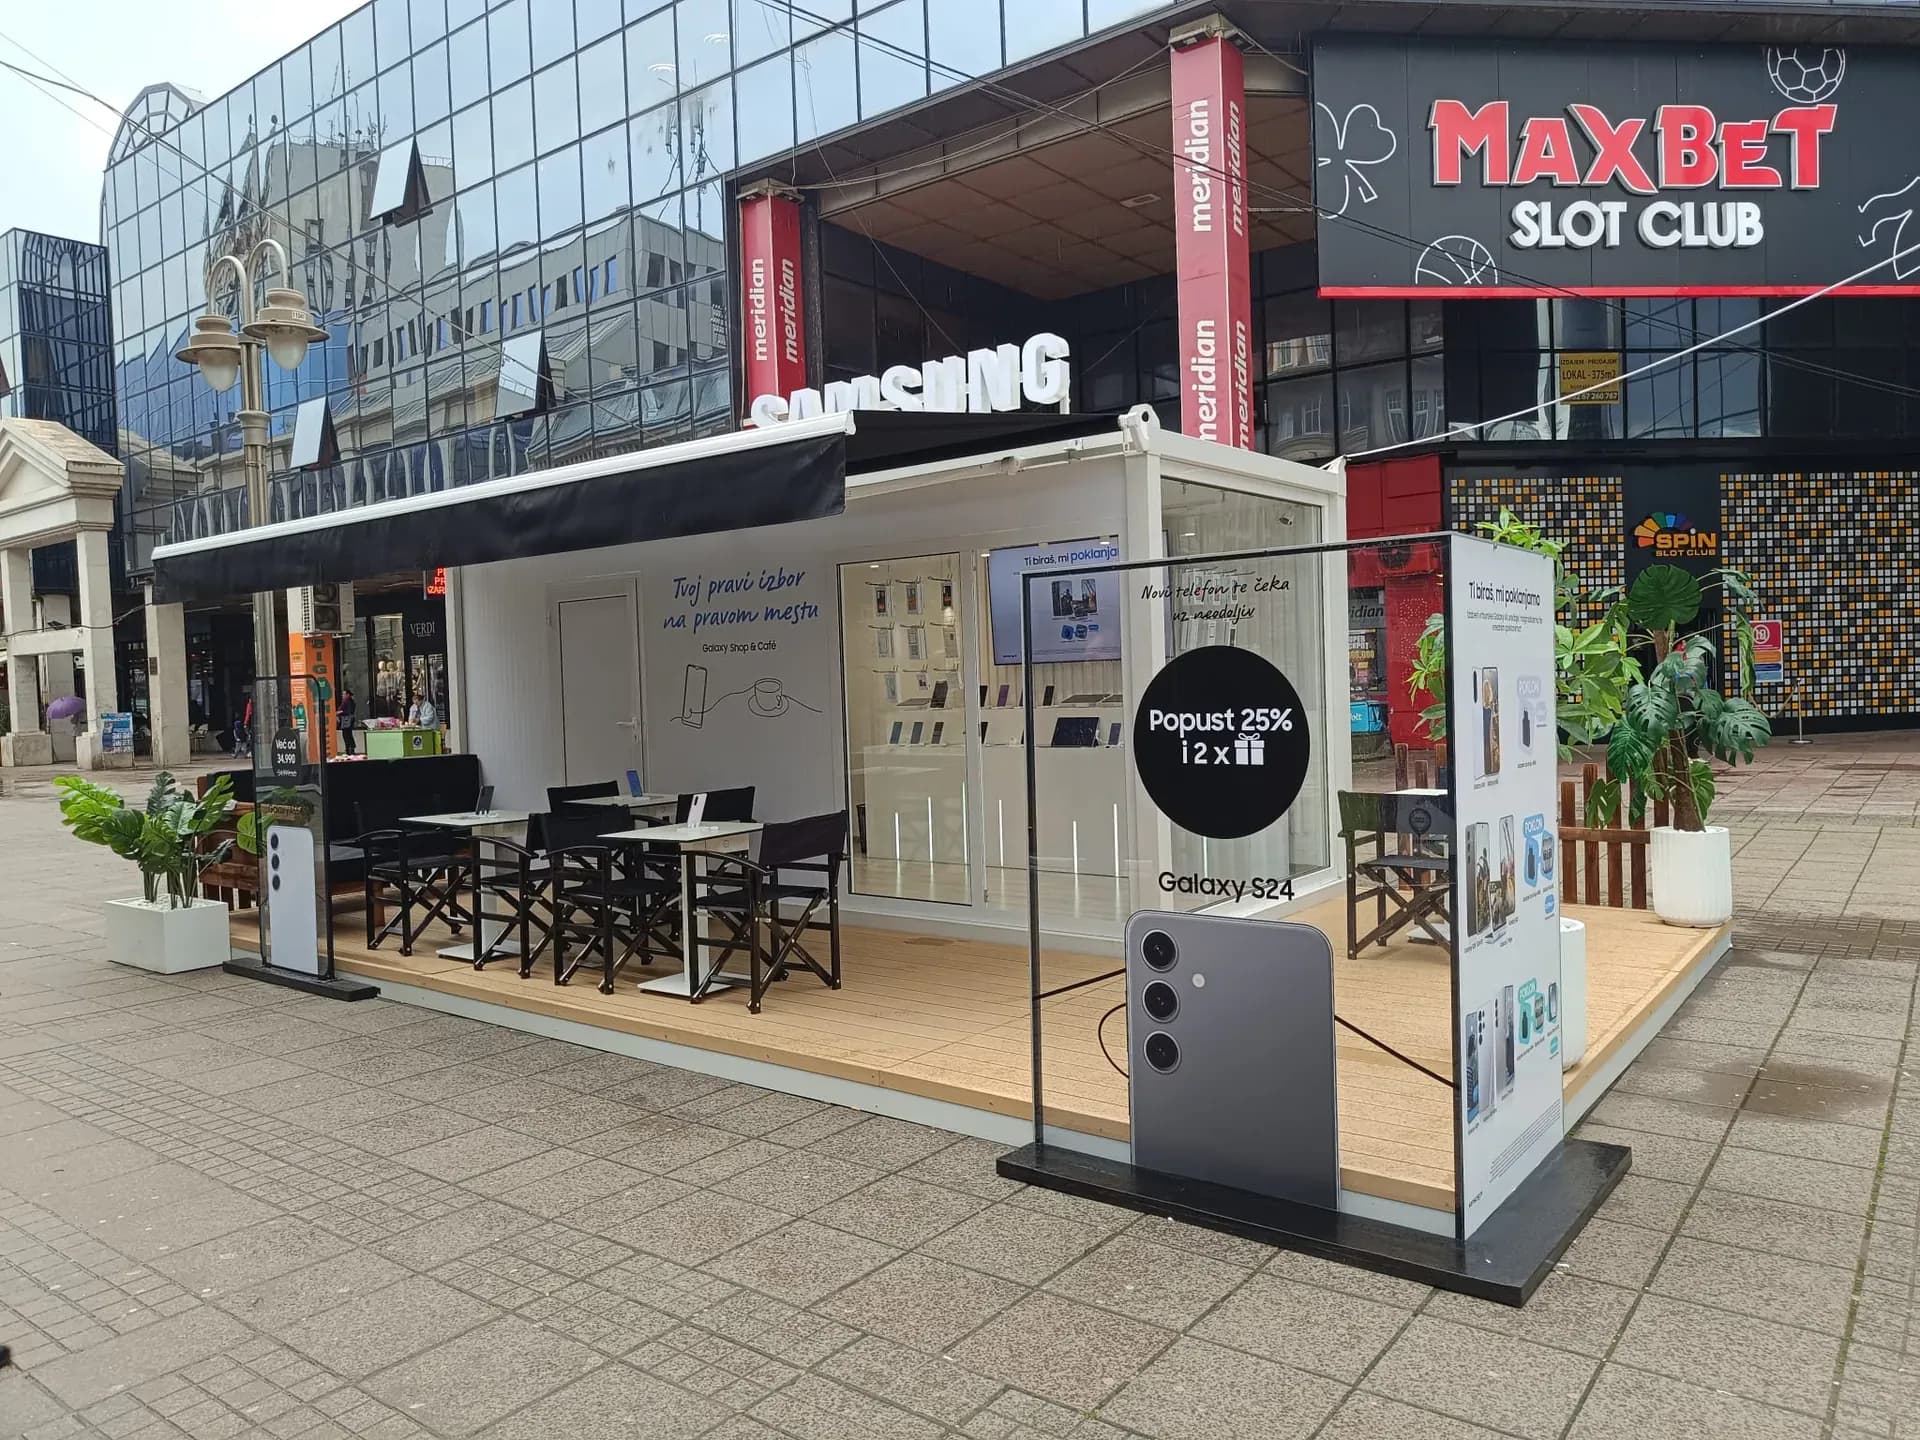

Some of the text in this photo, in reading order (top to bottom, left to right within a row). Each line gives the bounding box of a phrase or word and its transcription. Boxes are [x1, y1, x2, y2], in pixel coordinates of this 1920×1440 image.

[1429, 100, 1837, 195] MAXBET
[1184, 99, 1211, 232] meridian
[1227, 101, 1243, 237] meridian
[1511, 201, 1764, 249] SLOT CLUB
[749, 259, 767, 361] meridian
[779, 259, 798, 363] meridian
[1562, 369, 1586, 380] LOKAL
[1058, 553, 1069, 563] mi
[1655, 549, 1685, 557] SLOT
[673, 567, 806, 607] Tvoj pravi izbor
[1141, 574, 1290, 603] Novi telefon te čeka
[1496, 584, 1504, 602] mi
[1505, 587, 1541, 611] poklanjamo
[409, 621, 436, 634] VERDI
[663, 601, 819, 635] na pravom mestu
[1173, 603, 1256, 625] uz neodoljiv
[702, 640, 777, 654] Galaxy Shop & Café
[1149, 708, 1294, 739] Popust 25%
[275, 739, 296, 750] Već od
[1182, 740, 1230, 765] i 2 x
[1158, 871, 1295, 903] Galaxy S24
